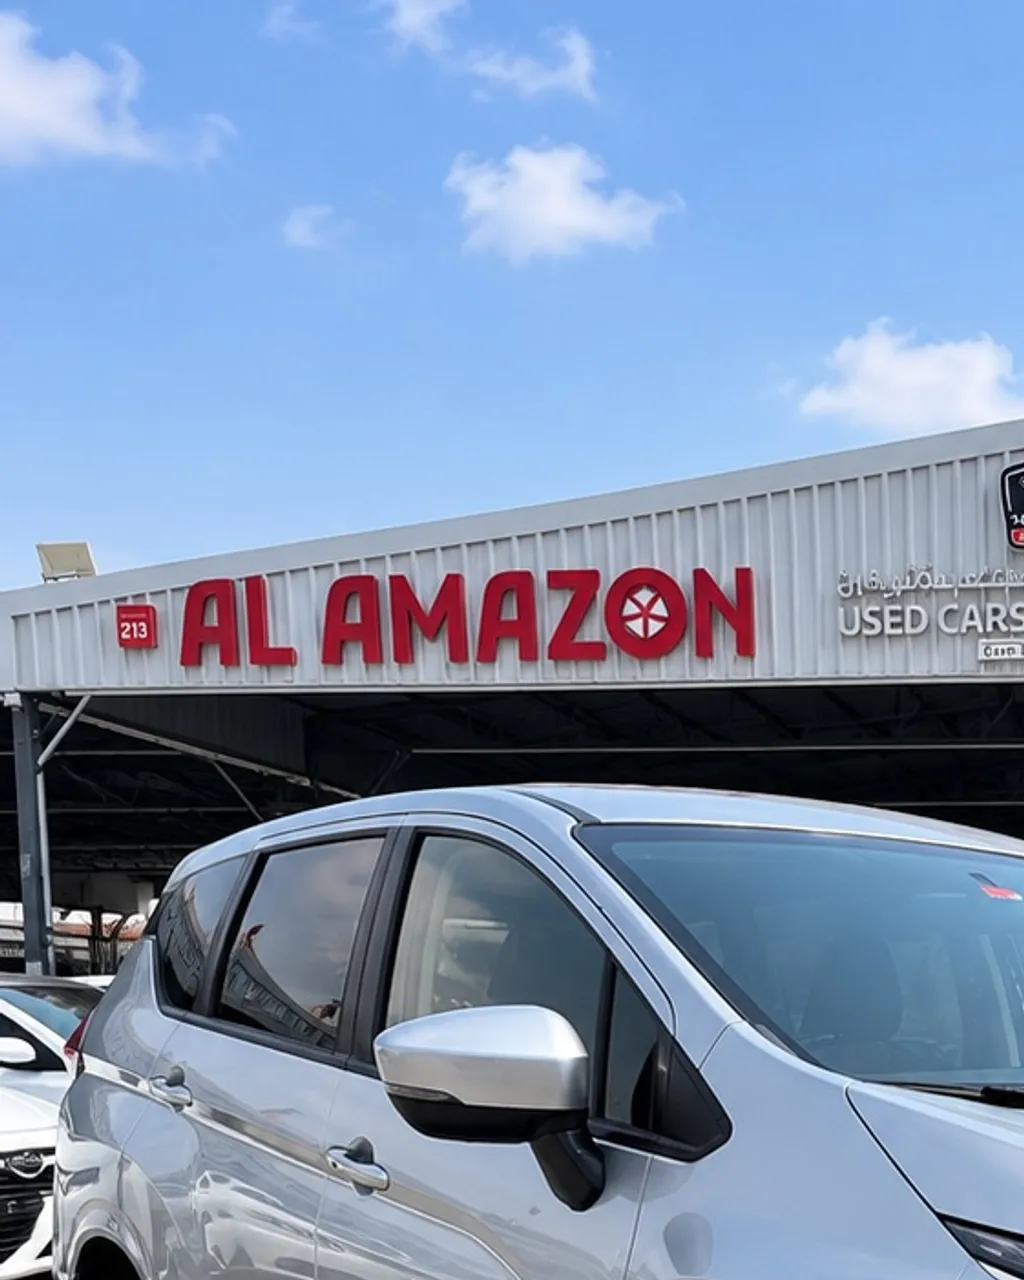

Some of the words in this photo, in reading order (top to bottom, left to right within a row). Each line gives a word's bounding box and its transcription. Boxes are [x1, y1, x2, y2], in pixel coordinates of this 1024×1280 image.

[120, 622, 148, 639] 213
[180, 574, 297, 667] AL
[321, 566, 756, 664] AMAZON
[838, 604, 929, 637] USED
